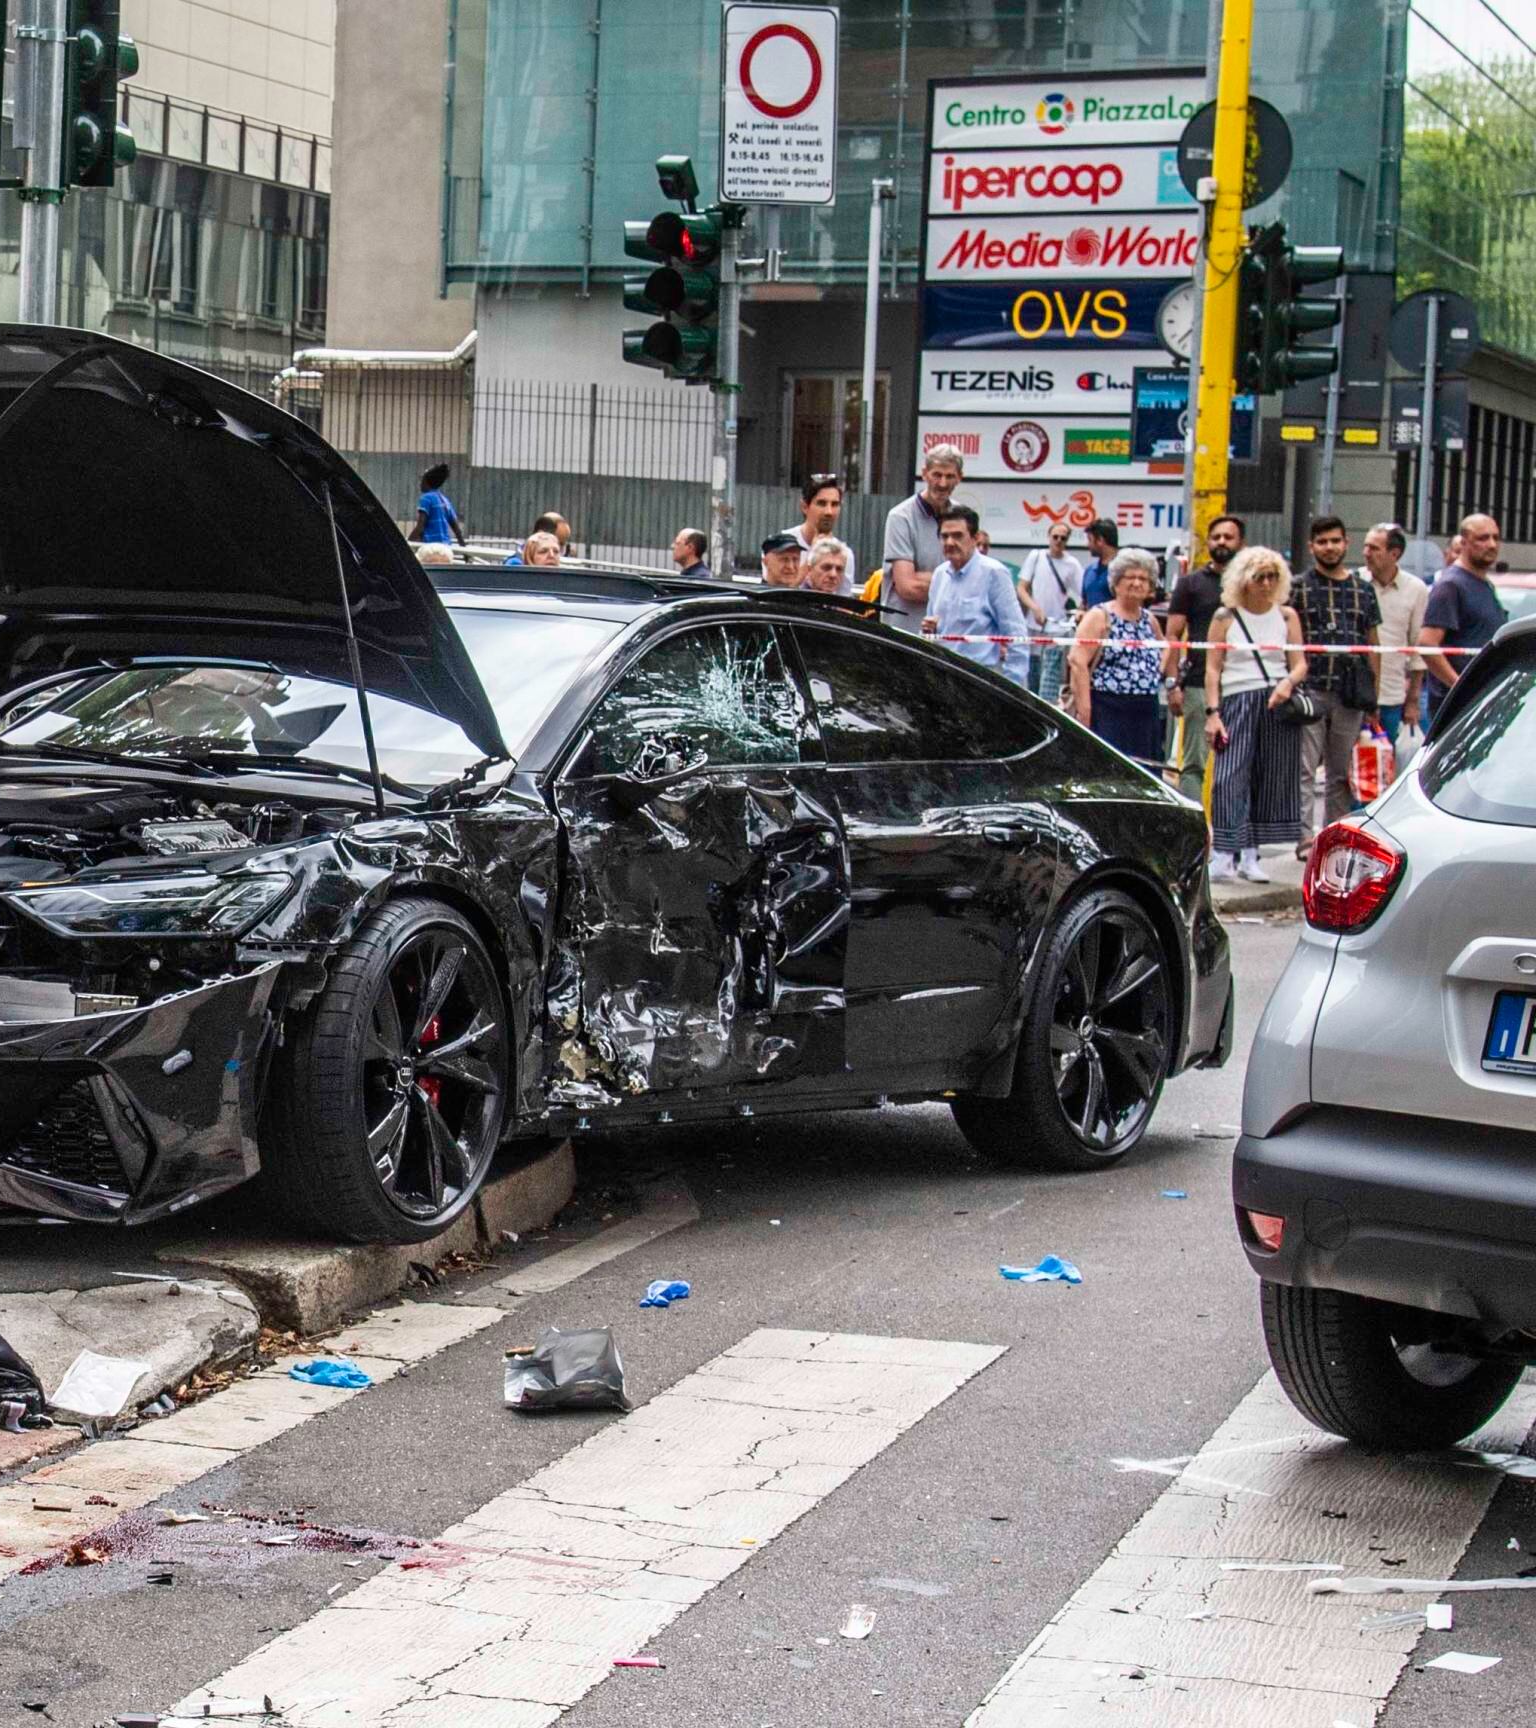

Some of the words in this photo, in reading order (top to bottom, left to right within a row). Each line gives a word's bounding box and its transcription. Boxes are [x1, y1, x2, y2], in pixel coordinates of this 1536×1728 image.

[752, 122, 779, 131] periodo
[783, 123, 819, 131] scolastico
[945, 102, 1026, 127] Centro
[943, 157, 1123, 211] ipercoop
[938, 229, 1063, 269] Media
[1012, 290, 1127, 339] OVS
